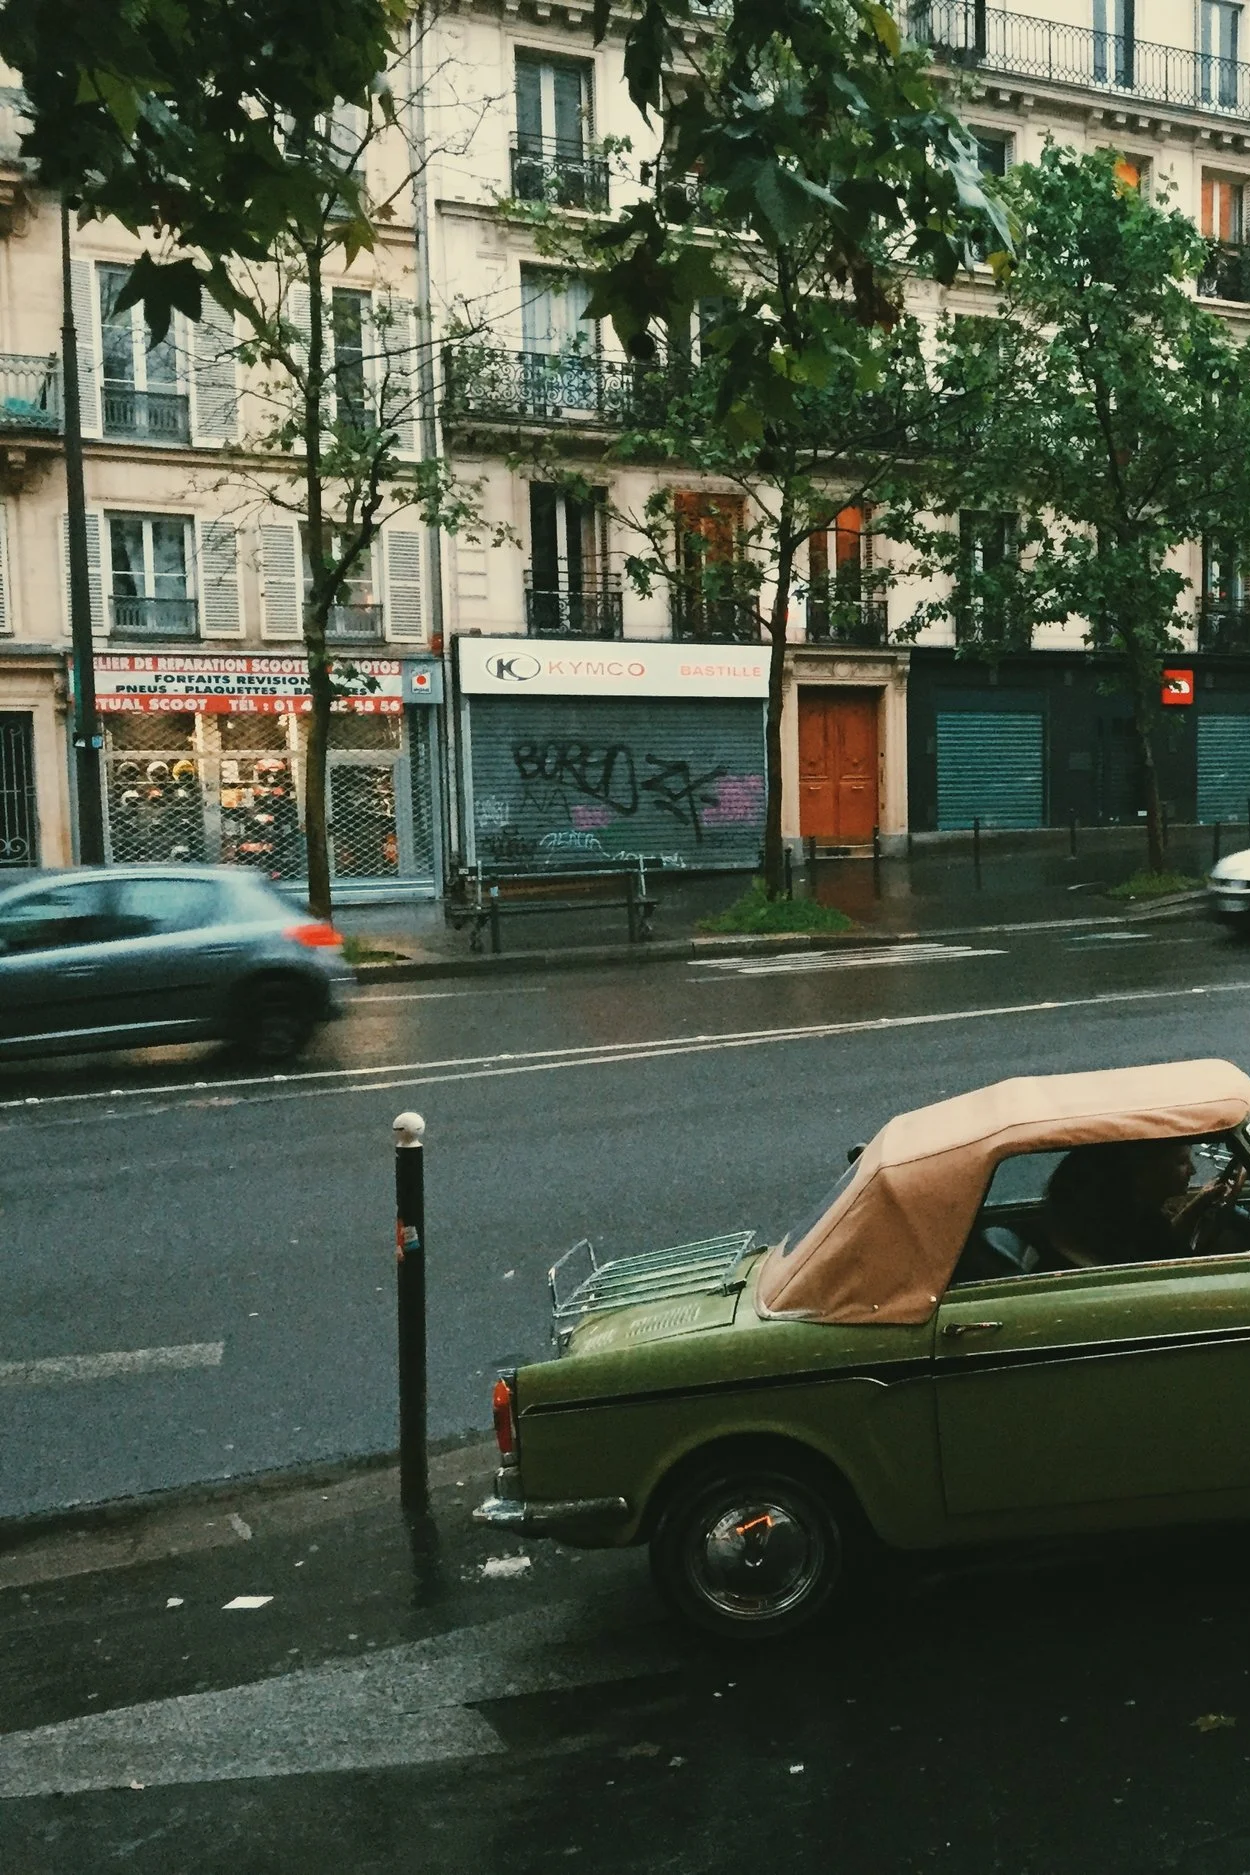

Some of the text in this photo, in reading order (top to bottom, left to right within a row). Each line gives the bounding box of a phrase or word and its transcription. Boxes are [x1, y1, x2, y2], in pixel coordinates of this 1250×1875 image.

[134, 657, 153, 670] DE
[251, 659, 309, 673] SCOOTE
[548, 660, 761, 677] KYMCO BASTILLE
[154, 674, 231, 684] FORFAITS
[115, 684, 167, 693] PNEUS
[185, 685, 277, 695] PLAQUETTES
[95, 698, 143, 710] TUAL
[149, 698, 207, 711] SCOOT
[274, 700, 293, 713] 01
